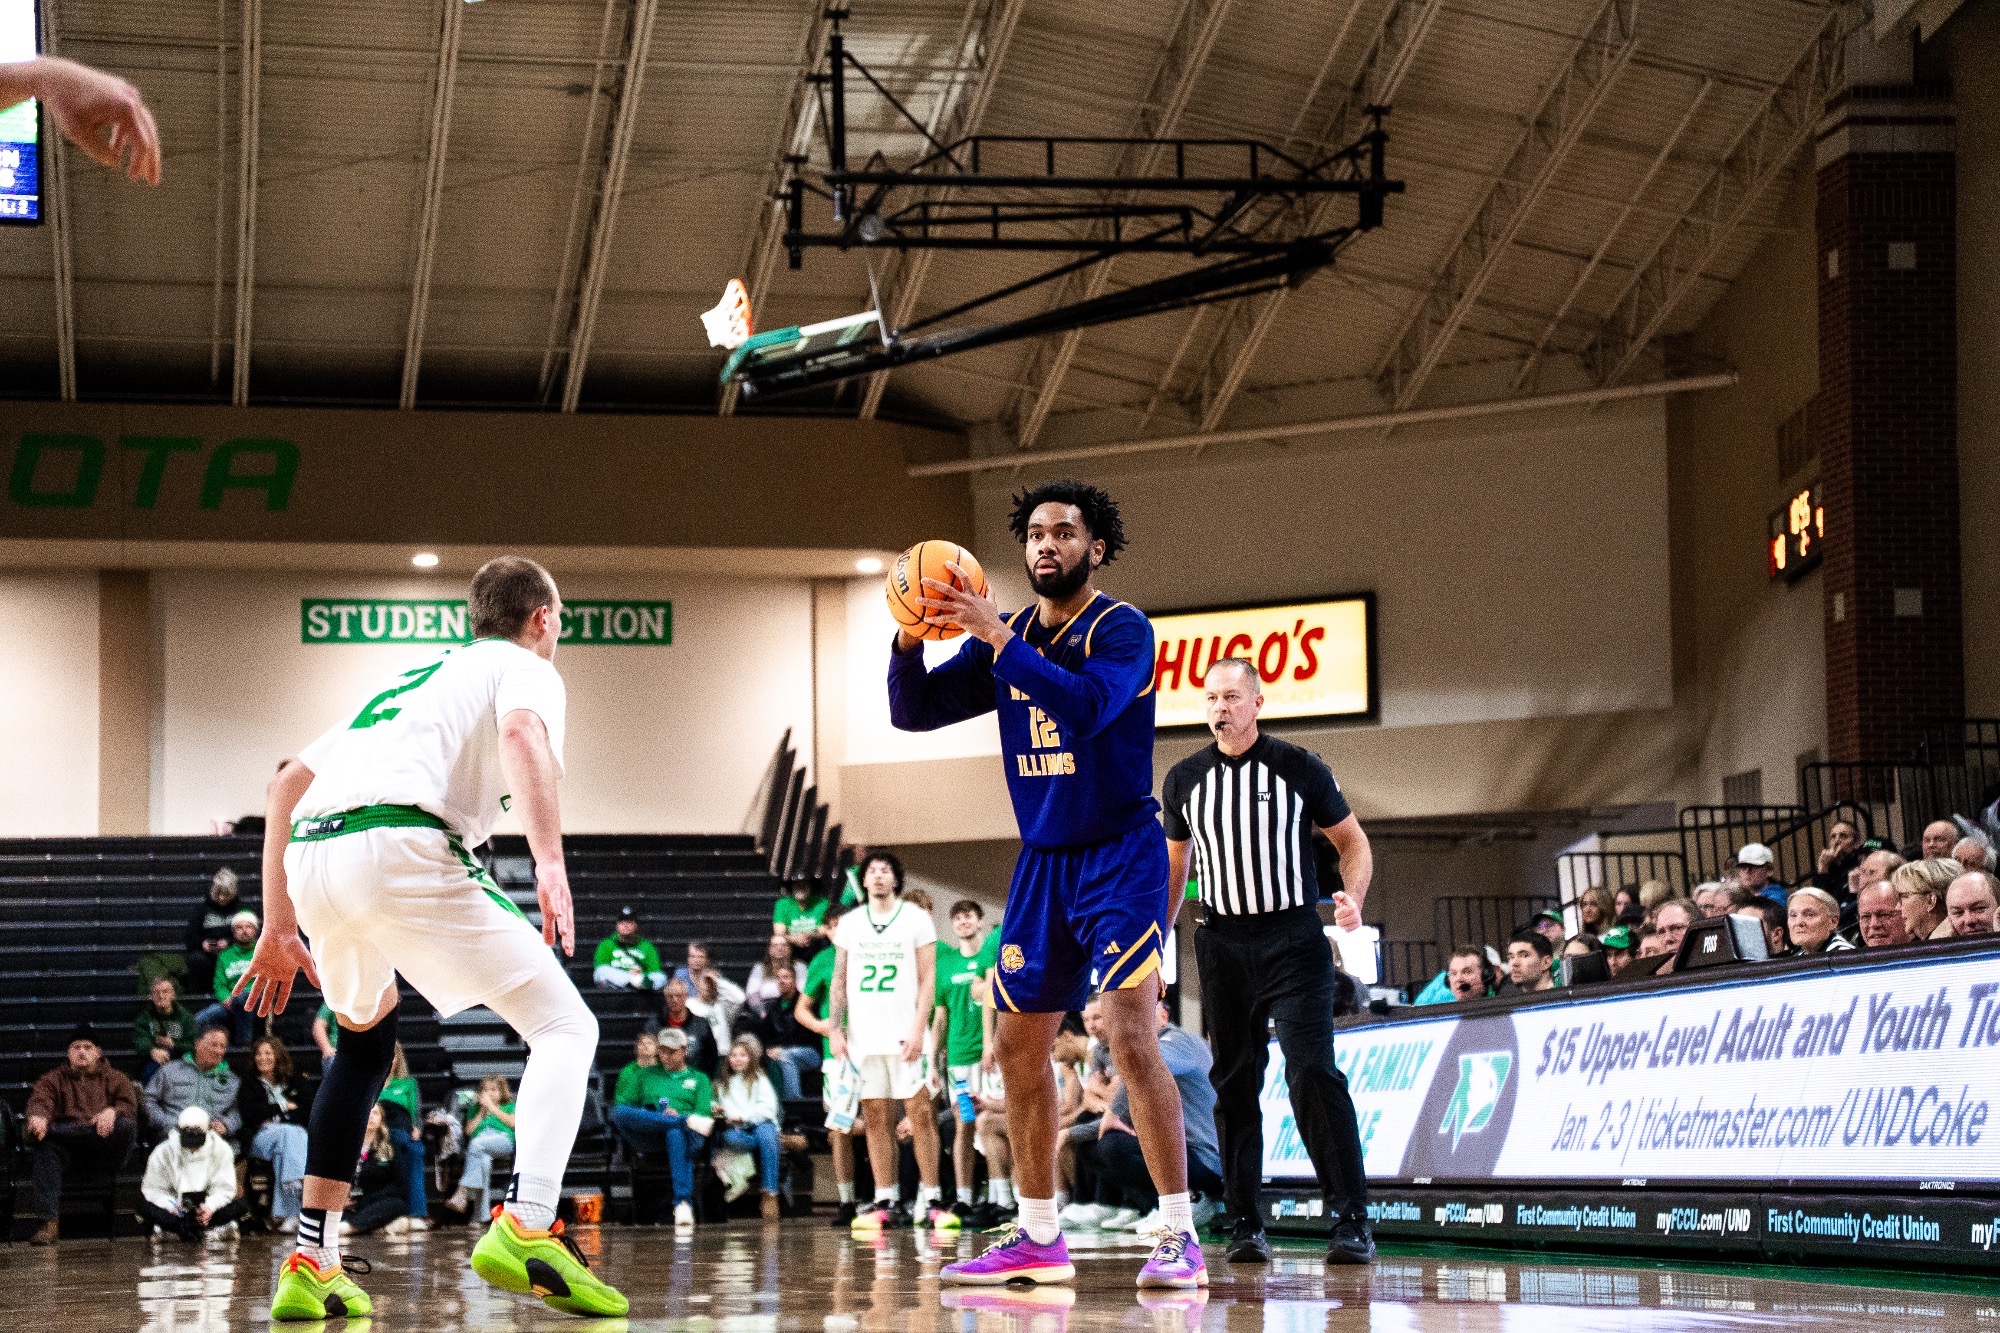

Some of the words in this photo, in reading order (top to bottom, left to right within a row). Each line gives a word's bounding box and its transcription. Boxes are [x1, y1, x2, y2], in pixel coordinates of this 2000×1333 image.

[307, 605, 467, 638] STUDEN
[560, 606, 666, 639] CTION
[1028, 706, 1060, 749] 12
[1016, 752, 1076, 777] ILLINIS
[1257, 792, 1271, 801] TW
[859, 964, 898, 992] 22
[1535, 1024, 1583, 1083] $15
[1579, 1009, 1722, 1087] Upper-Level
[1713, 1002, 1795, 1065] Adult
[1791, 994, 1859, 1059] and
[1859, 986, 1951, 1055] Youth
[1354, 1039, 1434, 1094] FAMILY
[1551, 1102, 1588, 1151] Jan.
[1590, 1099, 1632, 1151] 2-3
[1638, 1084, 1988, 1150] ticketmaster.com/UNDCoke
[1919, 1181, 1956, 1190] DAKTRONICS
[1401, 1201, 1421, 1221] Union
[1434, 1203, 1504, 1228] myFCCU.com/UND
[1517, 1204, 1536, 1225] First
[1536, 1204, 1582, 1231] Community
[1582, 1205, 1610, 1227] Credit
[1610, 1206, 1636, 1228] Union
[1656, 1208, 1751, 1237] myFCCU.com/UND
[1768, 1209, 1793, 1233] First
[1794, 1209, 1860, 1244] Community
[1862, 1213, 1901, 1240] Credit
[1902, 1214, 1941, 1242] Union
